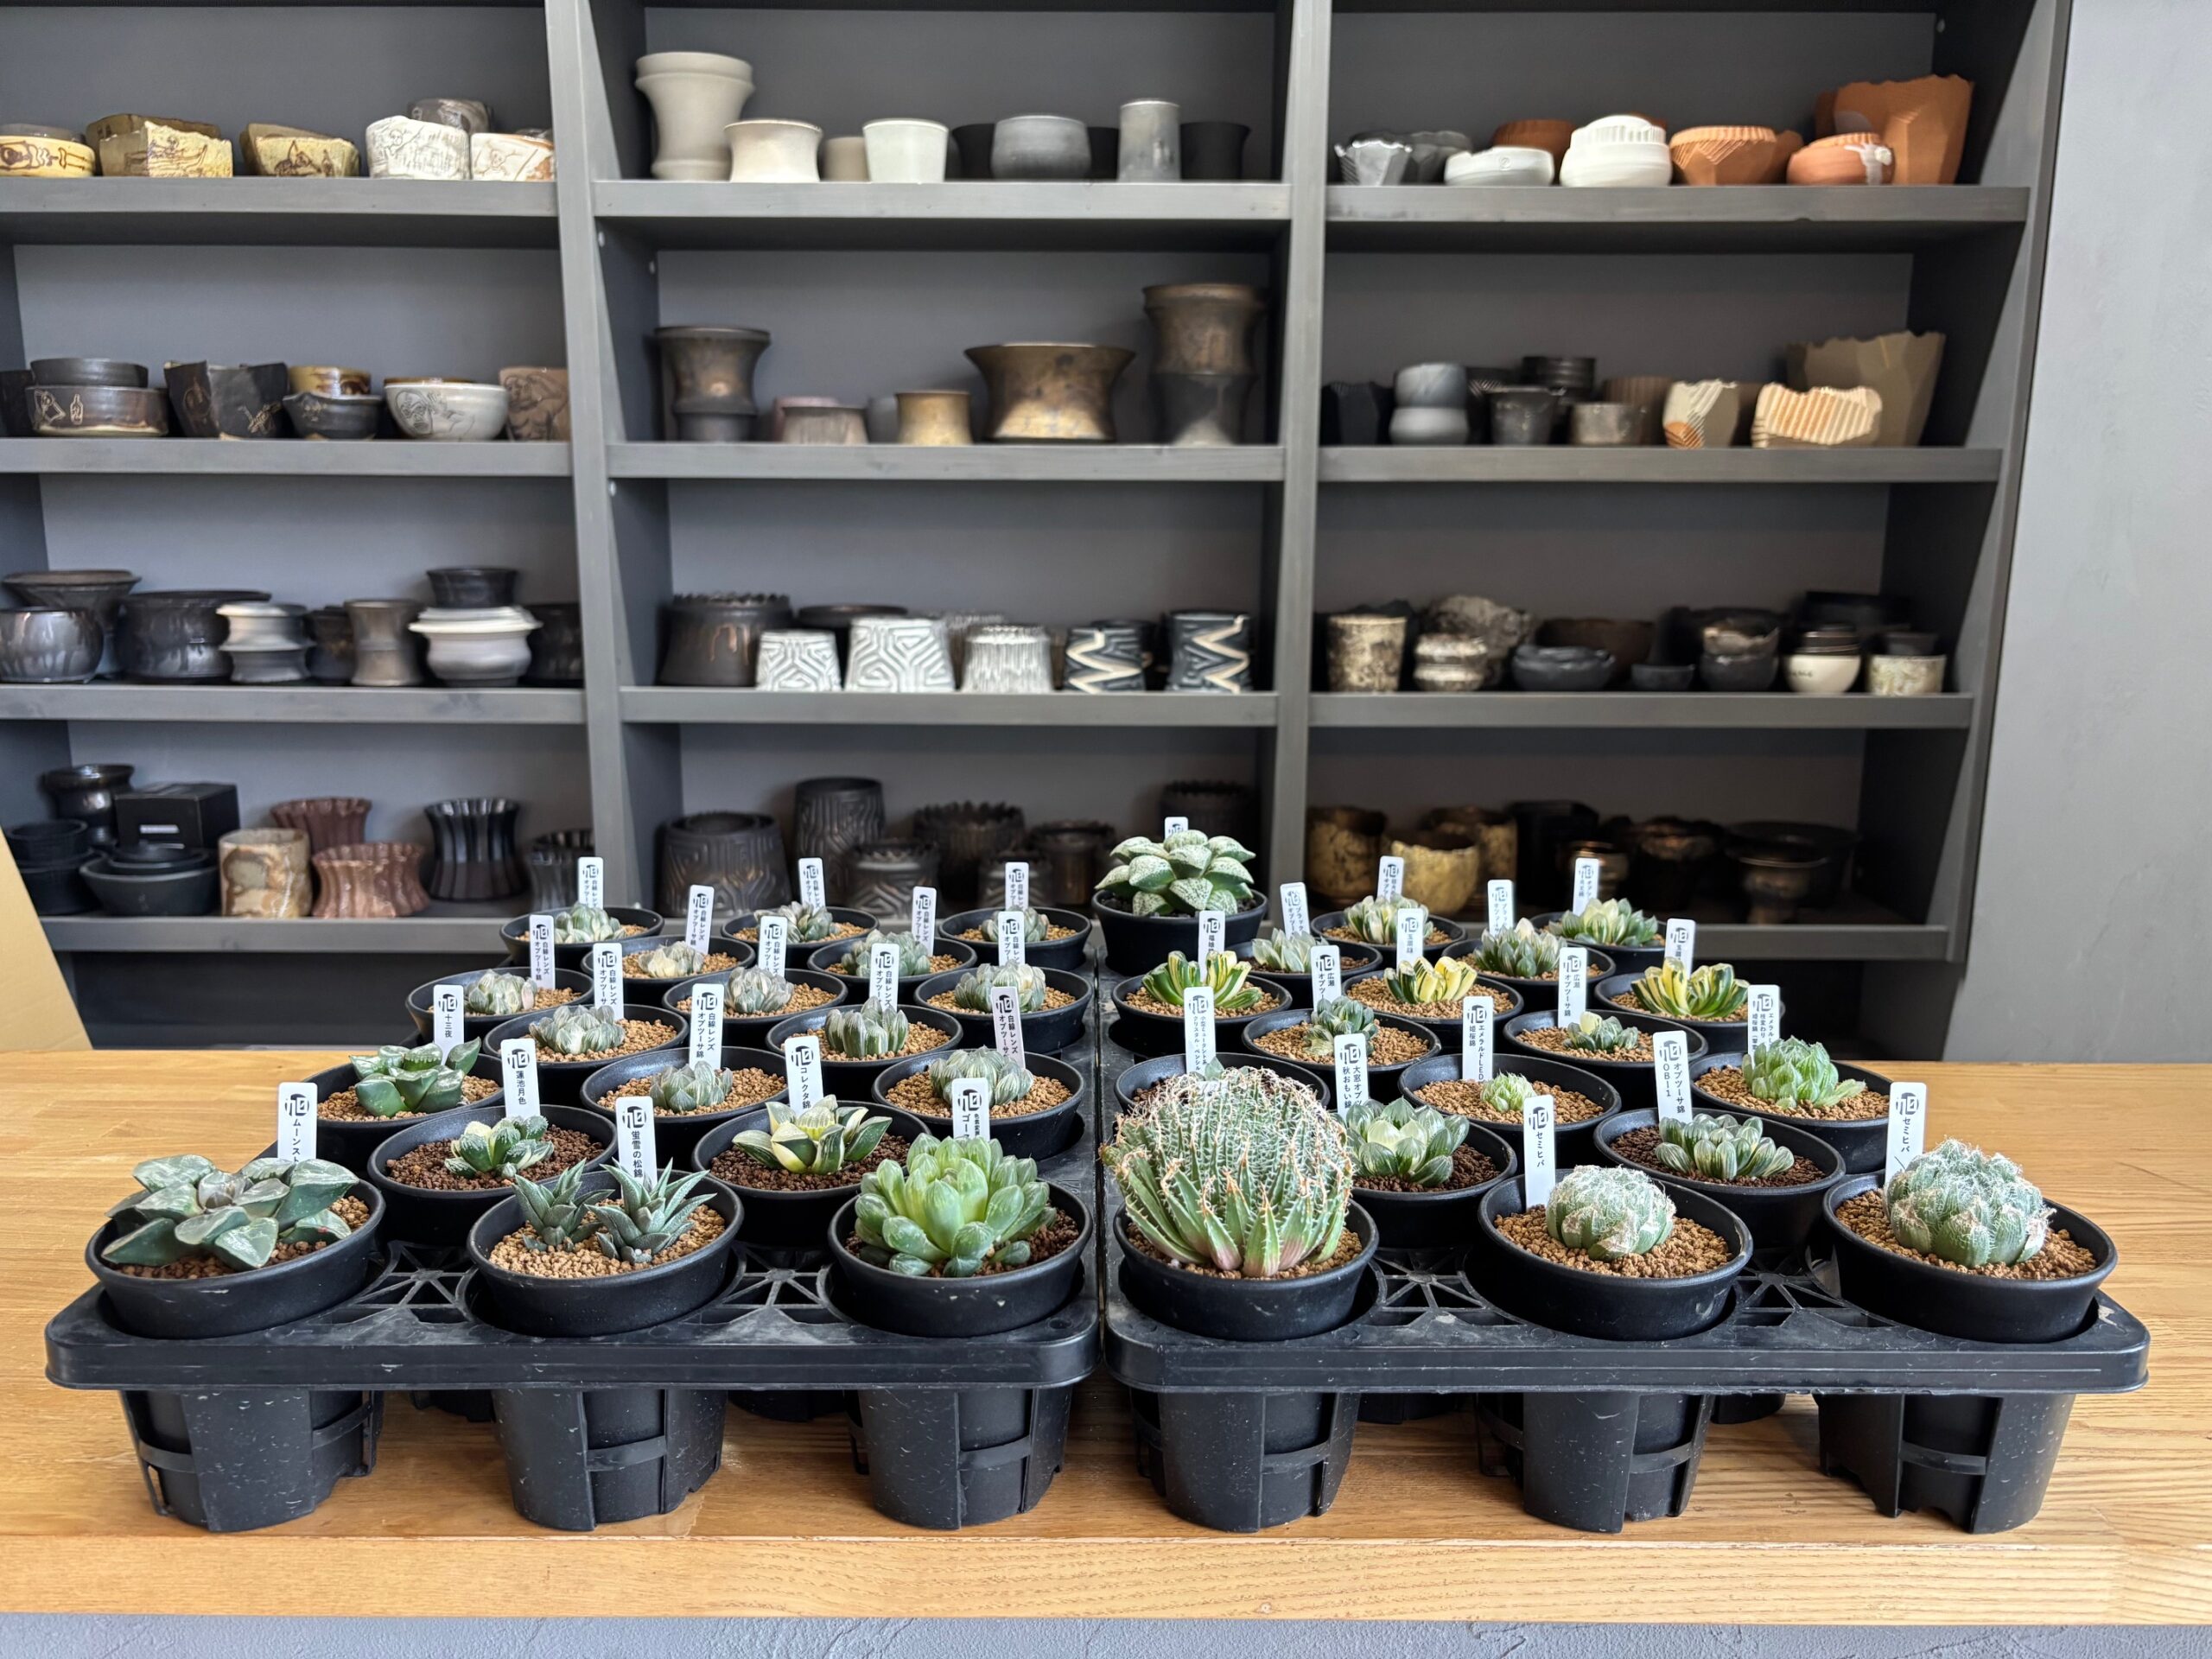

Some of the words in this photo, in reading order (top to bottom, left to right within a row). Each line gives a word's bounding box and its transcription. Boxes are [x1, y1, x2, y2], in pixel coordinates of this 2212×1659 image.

[444, 1014, 453, 1038] 十三夜
[999, 1014, 1009, 1057] オブツーサ
[800, 1067, 812, 1109] コレクタ錦
[1535, 1131, 1545, 1167] セミヒバ
[1900, 1117, 1910, 1153] セミヒバ
